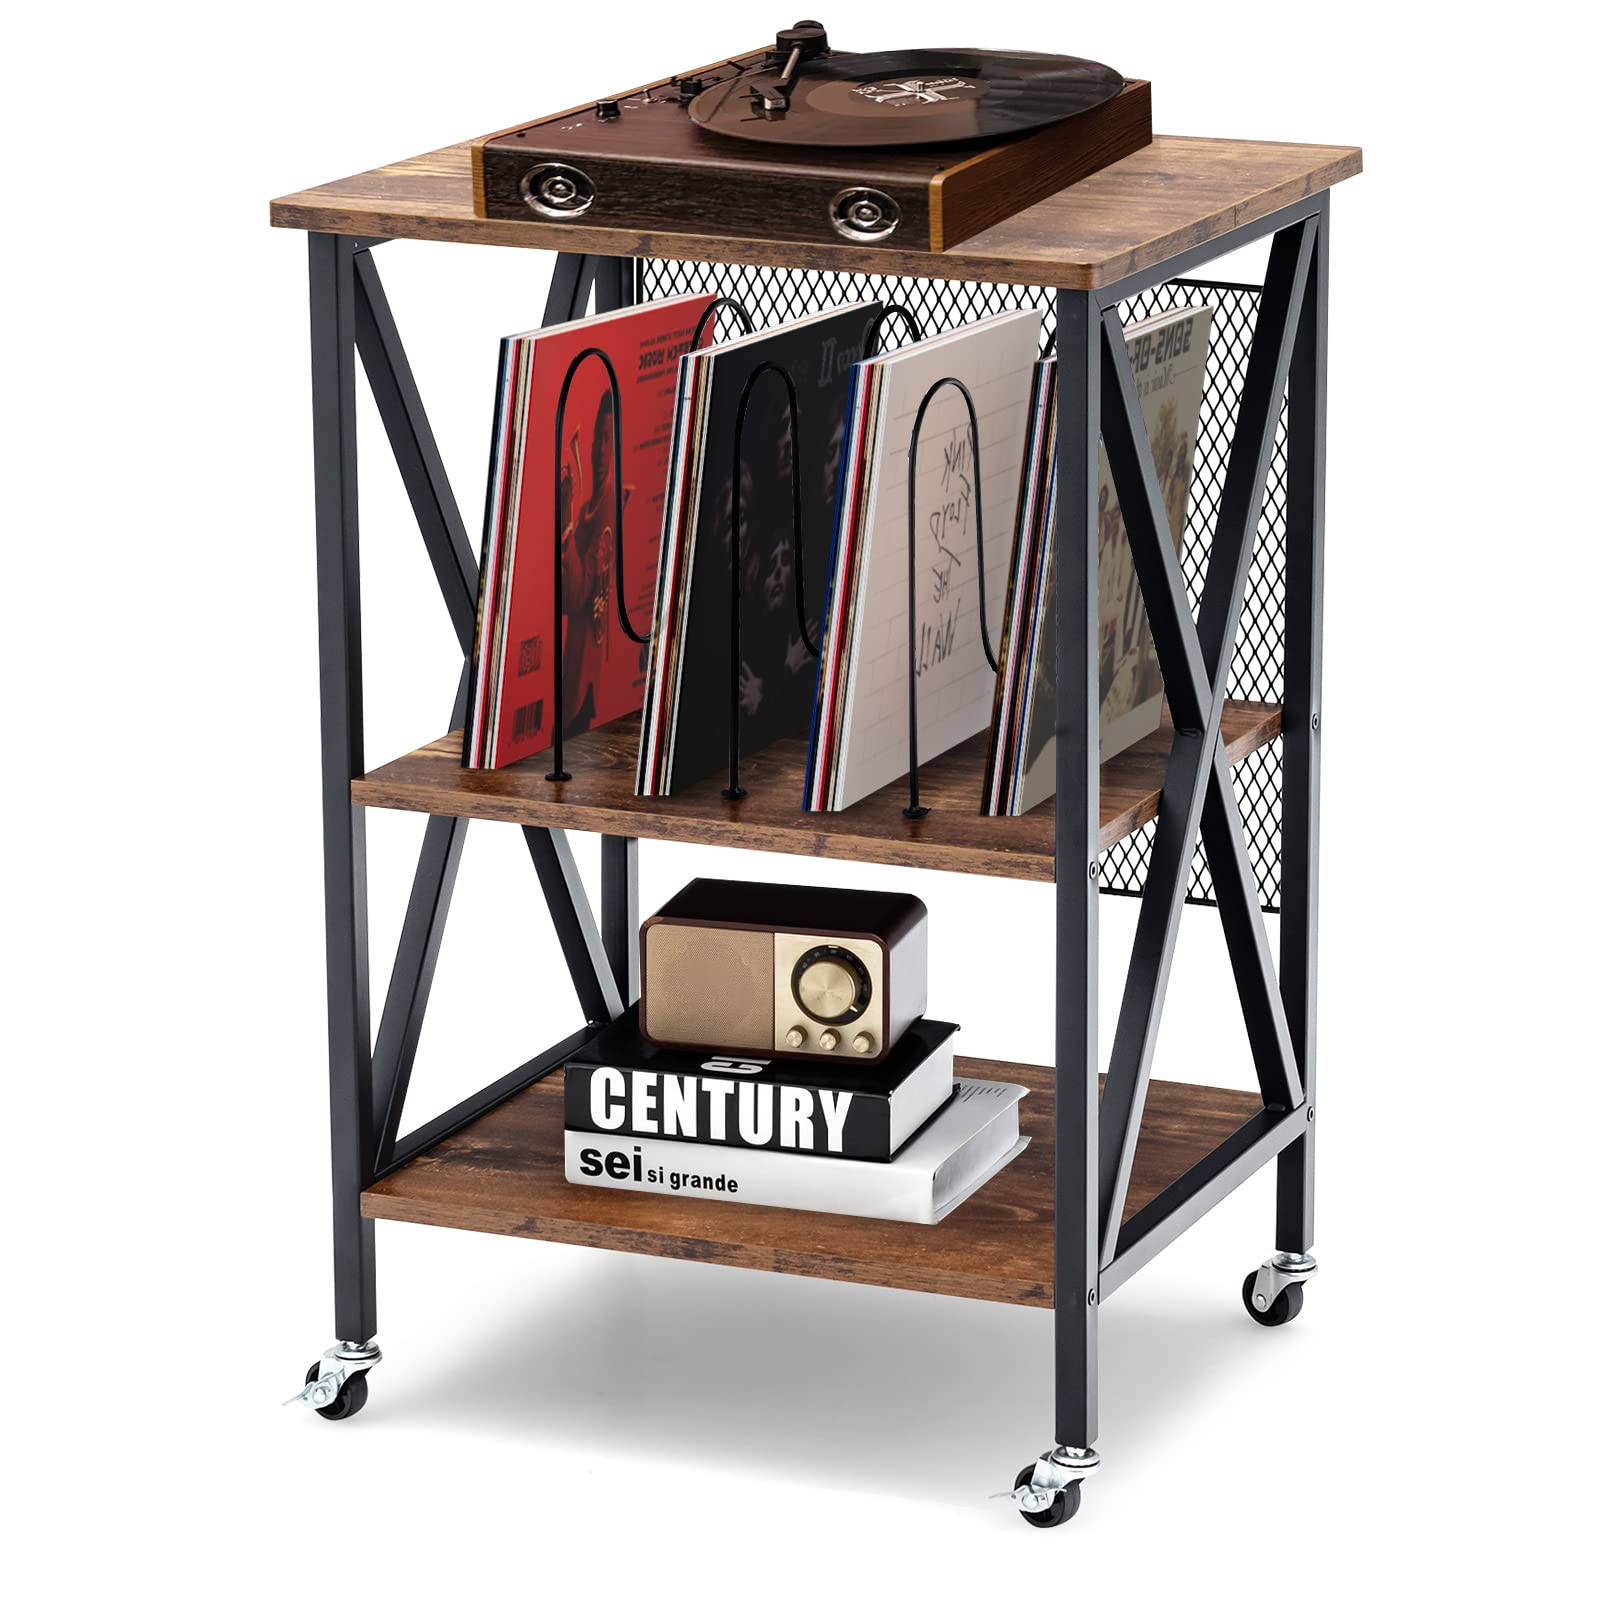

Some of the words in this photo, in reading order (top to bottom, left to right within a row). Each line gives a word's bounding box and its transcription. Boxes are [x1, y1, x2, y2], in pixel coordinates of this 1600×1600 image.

[590, 1066, 853, 1152] CENTURY
[579, 1146, 642, 1182] sei
[647, 1166, 664, 1184] si
[670, 1172, 739, 1194] grande
